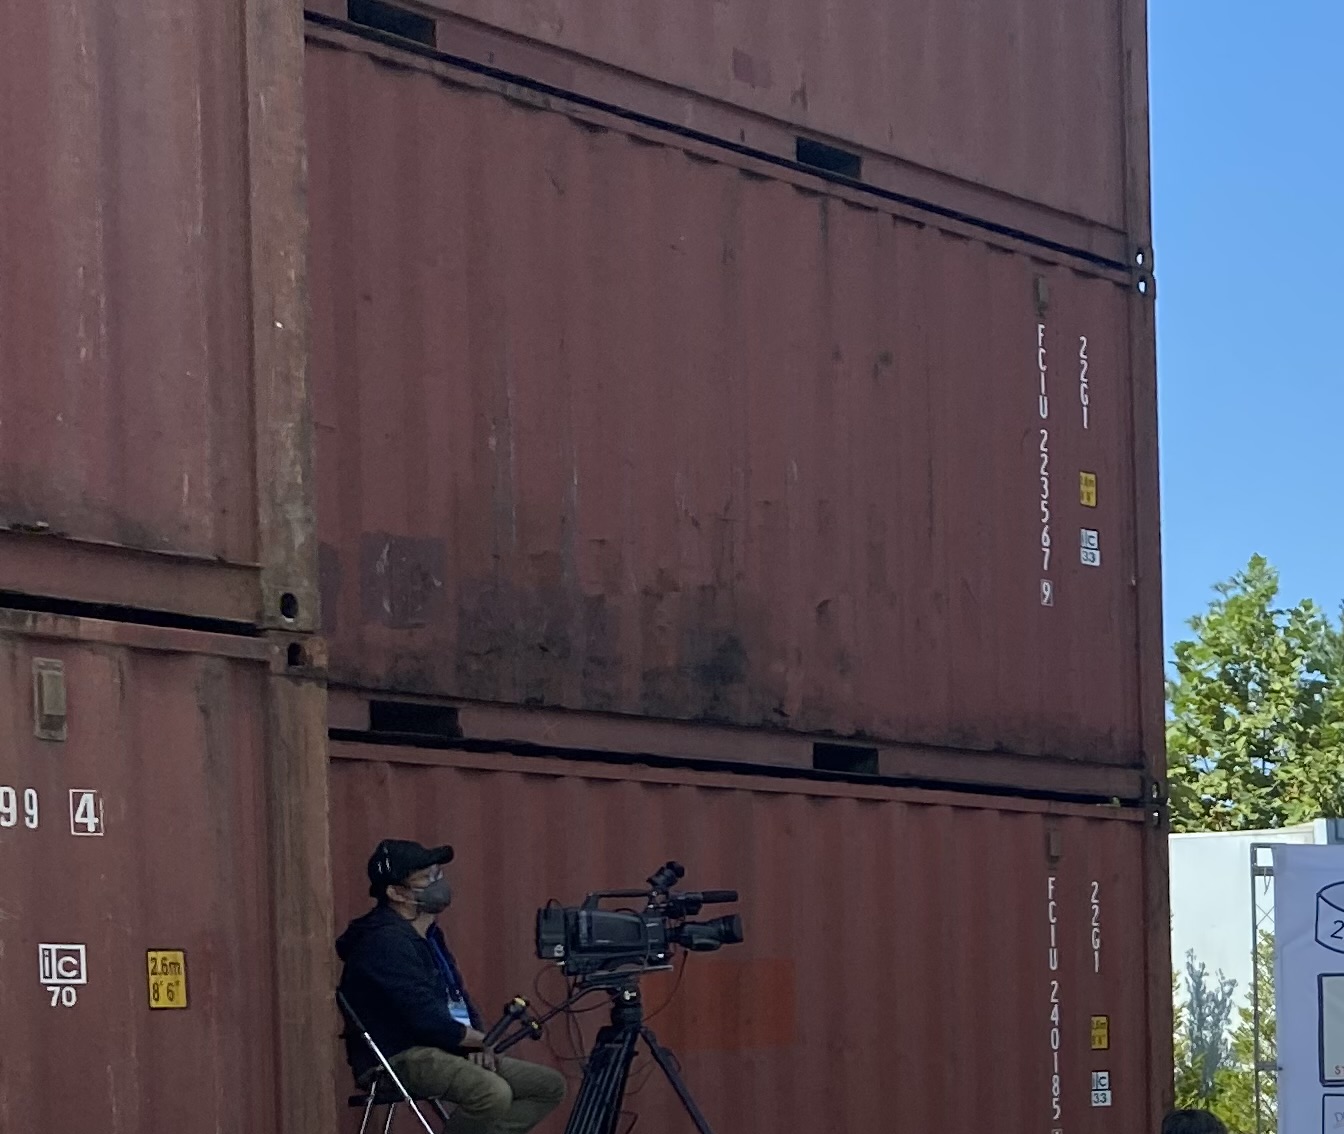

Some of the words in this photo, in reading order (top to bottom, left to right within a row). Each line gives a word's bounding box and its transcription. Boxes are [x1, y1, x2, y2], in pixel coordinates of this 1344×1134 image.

[75, 792, 100, 833] 4
[1048, 876, 1058, 971] FCIU
[150, 956, 182, 977] 2.6m
[46, 985, 77, 1008] 70
[1050, 980, 1061, 1120] 240185
